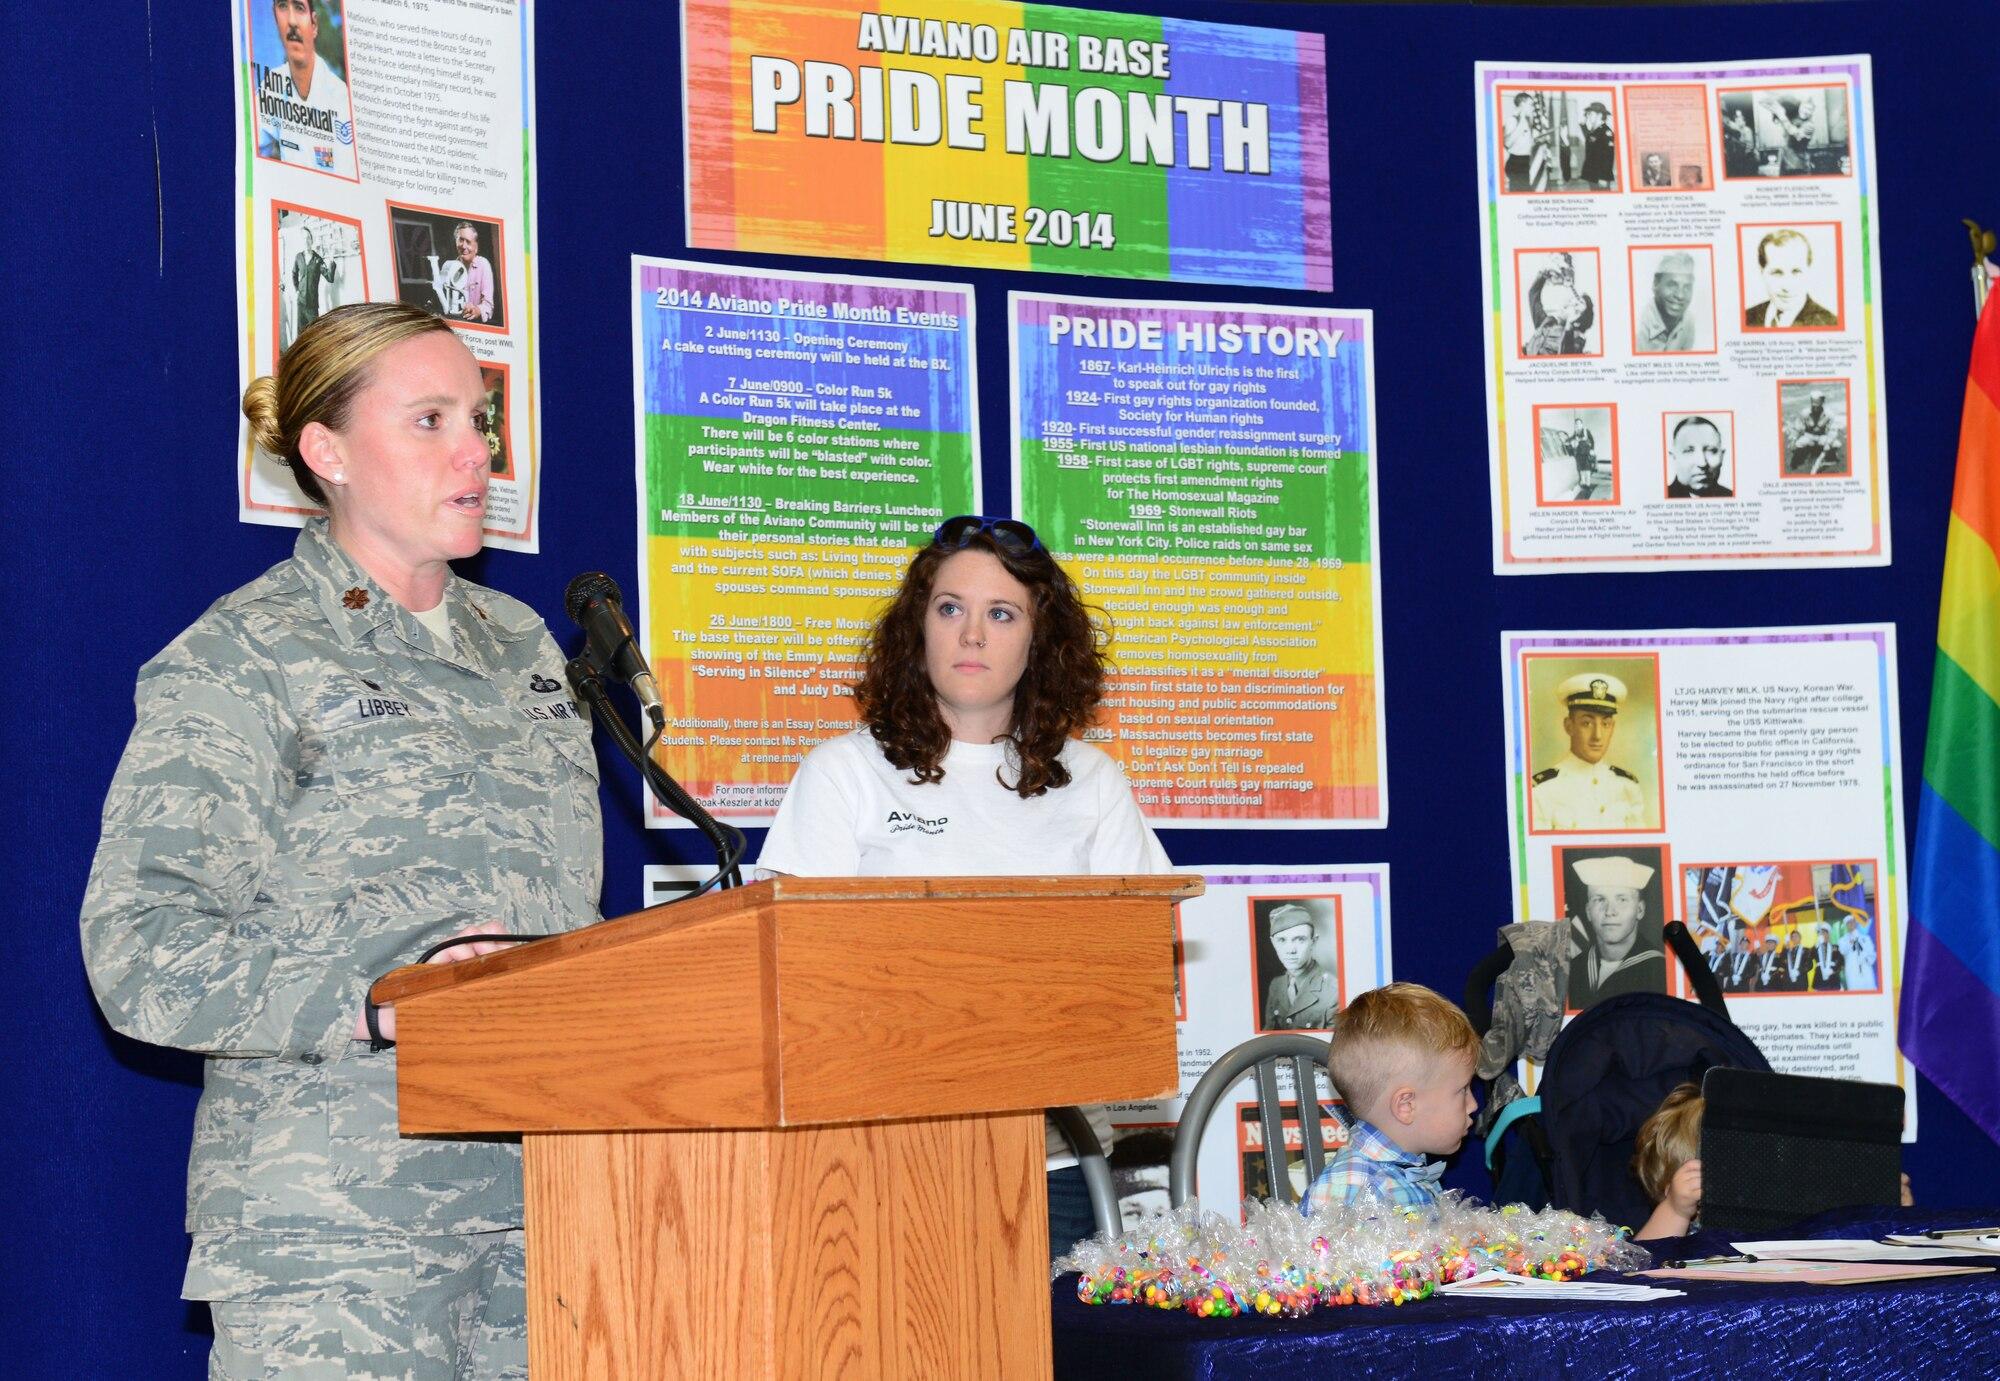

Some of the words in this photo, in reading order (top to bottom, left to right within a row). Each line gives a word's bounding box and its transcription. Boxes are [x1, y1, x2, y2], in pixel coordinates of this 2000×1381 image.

[858, 13, 998, 62] AVIANO
[1007, 28, 1069, 69] AIR
[1079, 34, 1171, 79] BASE
[264, 66, 283, 94] Am
[285, 76, 293, 97] a
[393, 87, 422, 99] October
[424, 91, 441, 102] 1975.
[751, 55, 986, 151] PRIDE
[1004, 80, 1271, 174] MONTH
[387, 165, 396, 173] me
[403, 168, 425, 179] medal
[426, 170, 435, 179] for
[437, 172, 457, 184] killing
[458, 177, 471, 185] two
[930, 199, 1016, 243] JUNE
[1024, 206, 1116, 249] 2014
[656, 288, 702, 309] 2014
[707, 292, 772, 314] Aviano
[773, 296, 827, 318] Pride
[832, 300, 891, 323] Month
[896, 305, 958, 327] Events
[705, 326, 713, 338] 2
[716, 327, 780, 342] June/1130
[793, 332, 844, 350] Opening
[847, 335, 909, 354] Ceremony
[1050, 314, 1163, 350] PRIDE
[1174, 321, 1344, 358] HISTORY
[662, 339, 671, 351] A
[673, 340, 704, 353] cake
[707, 342, 752, 359] cutting
[754, 348, 817, 364] ceremony
[819, 350, 842, 363] will
[845, 352, 861, 364] be
[863, 353, 890, 366] held
[892, 356, 905, 368] at
[908, 357, 928, 369] the
[930, 358, 951, 371] BX.
[1117, 360, 1195, 375] Karl-Heinrich
[1198, 364, 1240, 377] Ulrichs
[1242, 365, 1253, 378] is
[1255, 366, 1273, 378] the
[1276, 367, 1299, 379] first
[728, 377, 736, 389] 7
[739, 378, 803, 394] June/0900
[815, 382, 848, 396] Color
[850, 385, 874, 398] Run
[877, 386, 893, 399] 5k
[1113, 378, 1125, 389] to
[1127, 378, 1163, 393] speak
[1166, 380, 1186, 391] out
[1188, 380, 1206, 392] for
[1208, 383, 1230, 395] gay
[1232, 382, 1266, 397] rights
[743, 412, 787, 429] Dragon
[790, 415, 835, 429] Fitness
[837, 418, 882, 432] Center.
[1118, 408, 1162, 424] Society
[1165, 410, 1182, 422] for
[1185, 411, 1227, 424] Human
[1229, 412, 1263, 428] rights
[703, 460, 735, 473] Wear
[738, 462, 773, 475] white
[776, 464, 794, 476] for
[797, 465, 817, 478] the
[820, 467, 847, 479] best
[849, 468, 919, 486] experience.
[679, 494, 694, 506] 18
[697, 495, 762, 509] June/1130
[775, 498, 830, 515] Breaking
[833, 500, 881, 514] Barriers
[884, 502, 943, 517] Luncheon
[1107, 488, 1124, 499] for
[1126, 488, 1149, 500] The
[1151, 489, 1224, 502] Homosexual
[1226, 491, 1280, 507] Magazine
[1168, 505, 1225, 518] Stonewall
[1227, 506, 1257, 519] Riots
[358, 699, 412, 718] LIBBEY
[525, 707, 552, 721] U.S.
[552, 703, 567, 720] AIR
[1678, 729, 1706, 739] Harvey
[1708, 728, 1741, 737] became
[1743, 728, 1757, 736] the
[1778, 727, 1807, 737] openly
[1810, 728, 1825, 736] gay
[1827, 727, 1858, 736] person
[1690, 740, 1701, 748] be
[1703, 739, 1734, 748] elected
[1735, 739, 1744, 747] to
[1746, 738, 1772, 748] public
[1774, 738, 1799, 746] office
[1811, 736, 1856, 745] California.
[1131, 744, 1143, 755] to
[1145, 744, 1187, 759] legalize
[1190, 748, 1210, 759] gay
[1213, 746, 1263, 761] marriage
[716, 786, 731, 794] For
[1139, 792, 1158, 804] ban
[1161, 793, 1171, 804] is
[1173, 793, 1263, 806] unconstitutional
[887, 811, 948, 826] Aviano
[890, 823, 915, 833] Pride
[1771, 1044, 1793, 1052] thirty
[1113, 1104, 1126, 1112] Los
[1129, 1104, 1158, 1112] Angeles.
